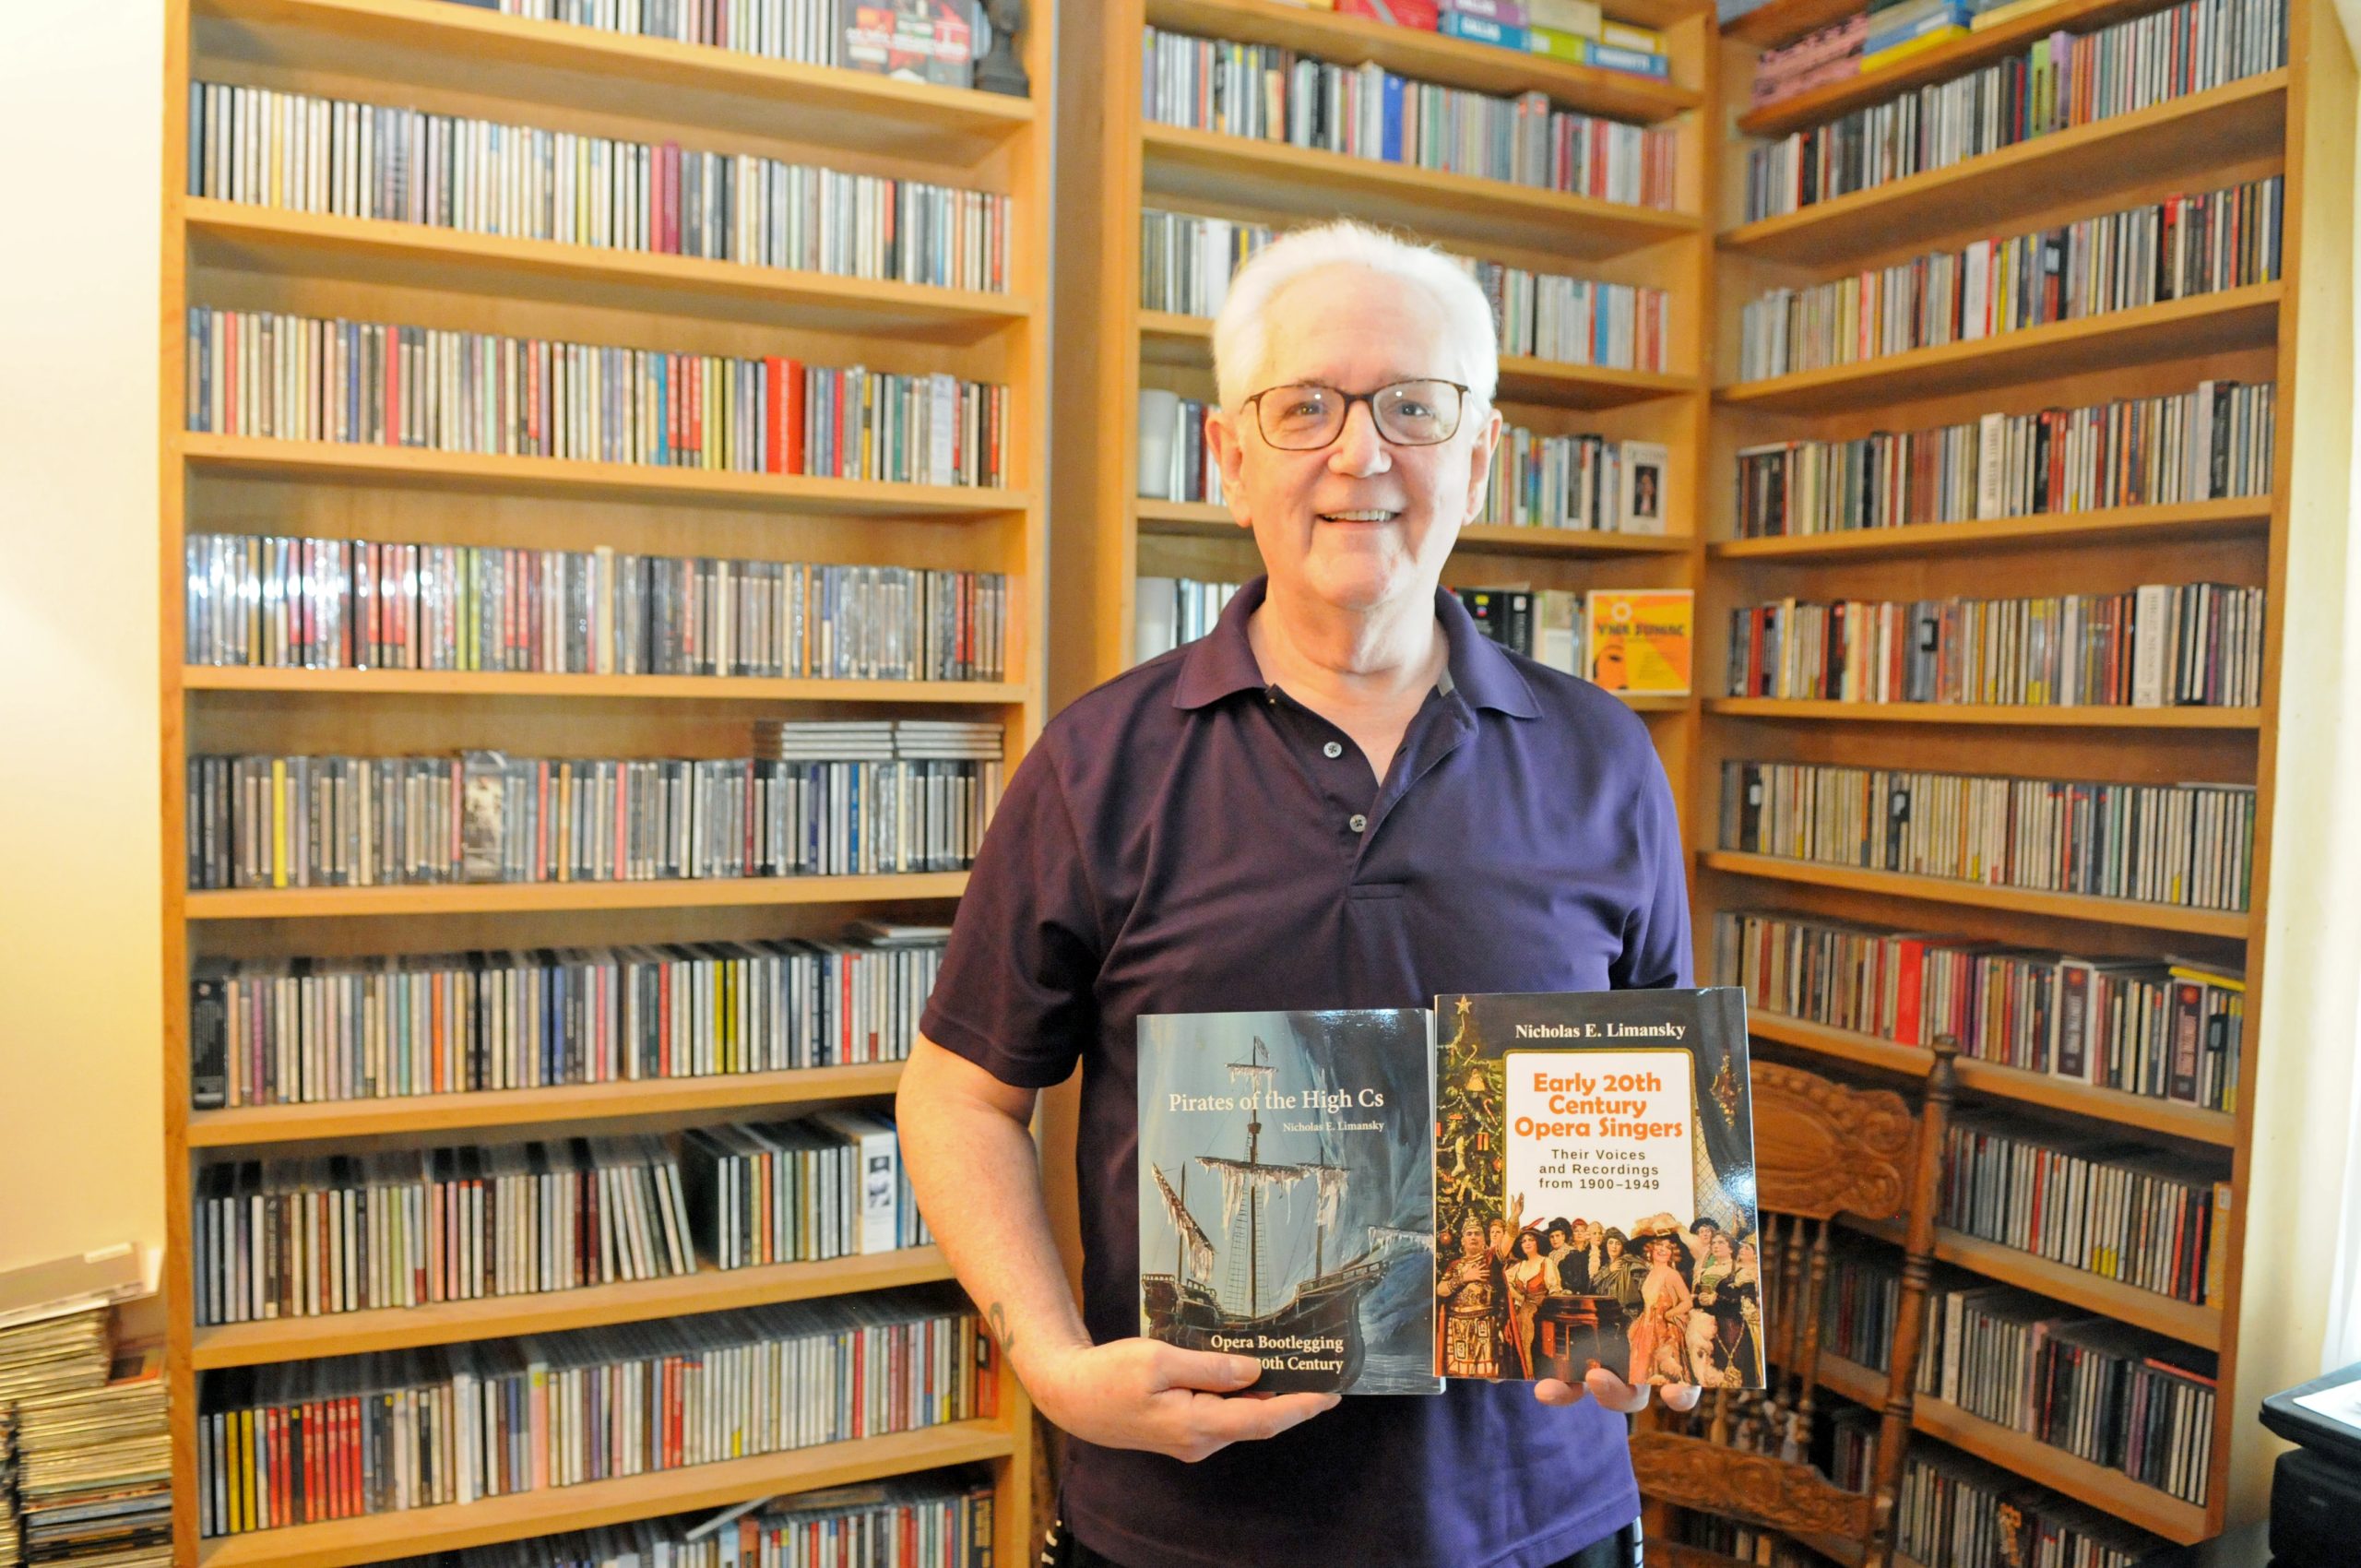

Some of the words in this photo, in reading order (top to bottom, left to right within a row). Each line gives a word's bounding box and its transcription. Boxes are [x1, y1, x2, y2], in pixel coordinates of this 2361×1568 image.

[1515, 1022, 1581, 1039] Nicholas
[1585, 1023, 1602, 1038] E.
[1607, 1022, 1686, 1039] Limansky
[1533, 1073, 1596, 1096] Early
[1603, 1073, 1661, 1092] 20th
[1169, 1093, 1234, 1112] Pirates
[1240, 1088, 1261, 1111] of
[1264, 1090, 1297, 1111] the
[1302, 1088, 1353, 1113] High
[1358, 1089, 1384, 1109] Cs
[1548, 1094, 1647, 1118] Century
[1283, 1123, 1323, 1132] Nicholas
[1325, 1123, 1335, 1132] E.
[1337, 1122, 1384, 1134] Limansky
[1514, 1117, 1591, 1140] Opera
[1598, 1116, 1683, 1140] Singers
[1551, 1149, 1590, 1161] Their
[1596, 1149, 1646, 1160] Voices
[1539, 1163, 1567, 1175] and
[1572, 1164, 1659, 1177] Recordings
[1538, 1178, 1572, 1189] from
[1210, 1335, 1254, 1350] Opera
[1258, 1334, 1344, 1352] Bootlegging
[1287, 1357, 1344, 1374] Century
